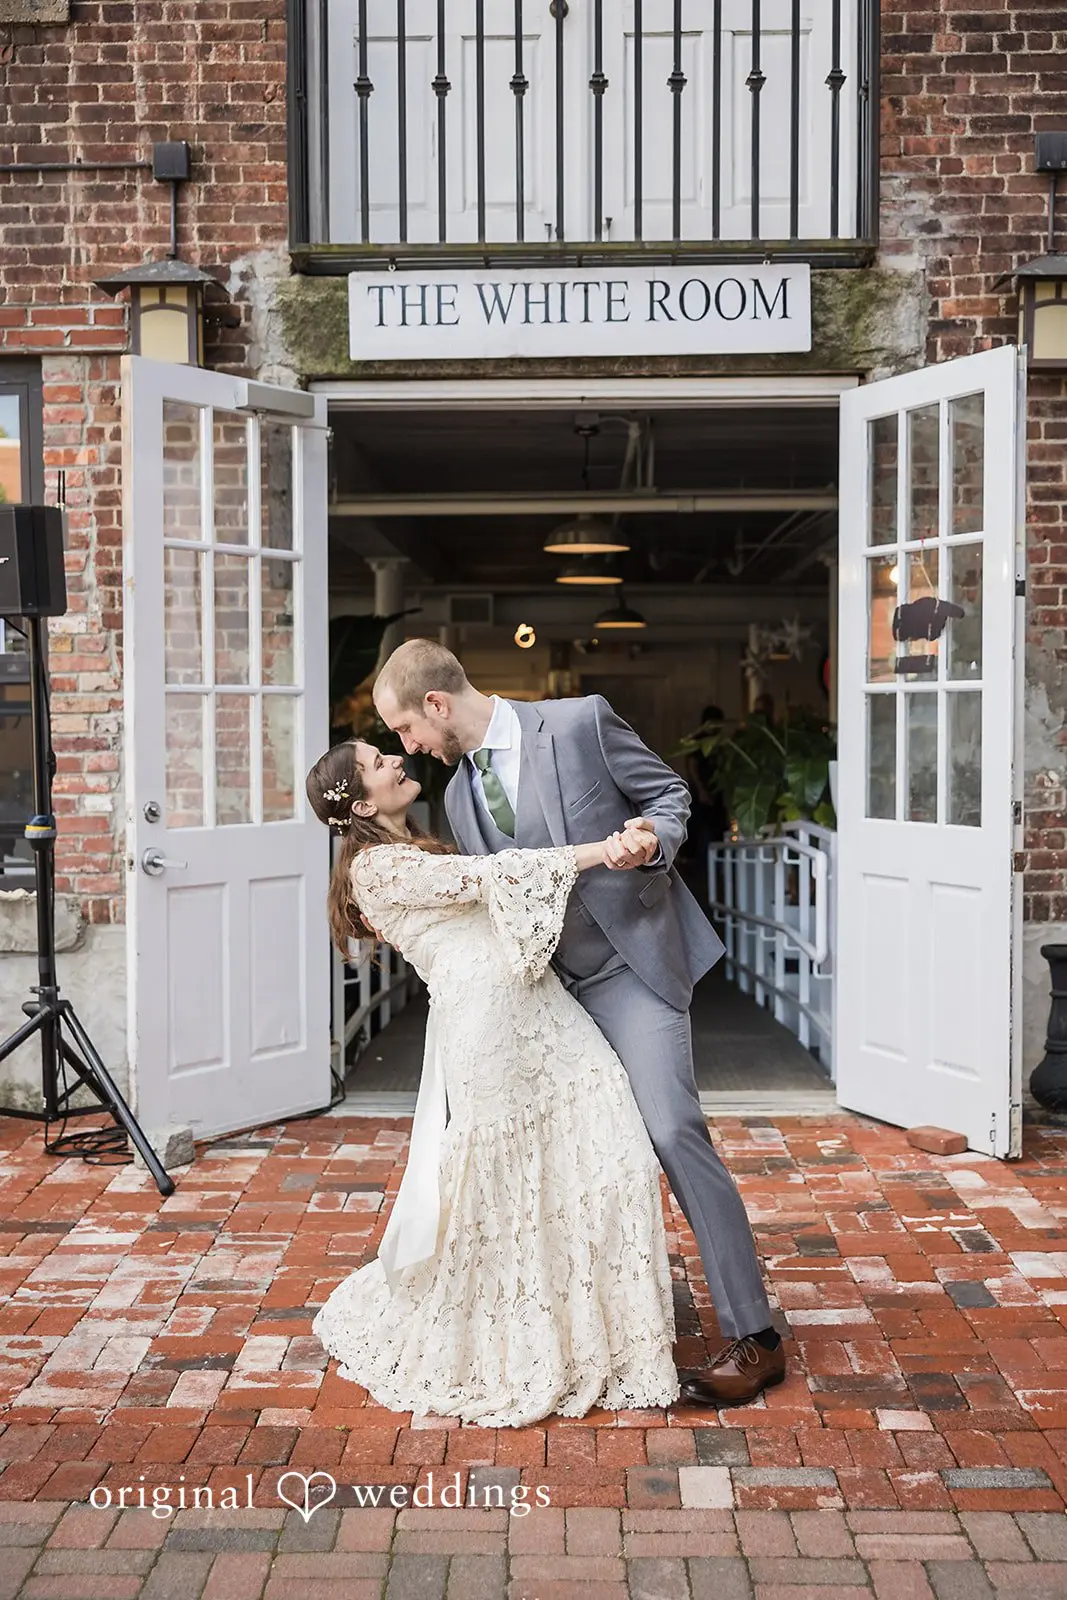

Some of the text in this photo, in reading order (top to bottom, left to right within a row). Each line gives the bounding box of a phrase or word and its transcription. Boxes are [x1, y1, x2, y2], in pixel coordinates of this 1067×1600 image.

[366, 277, 793, 327] THE WHITE ROOM
